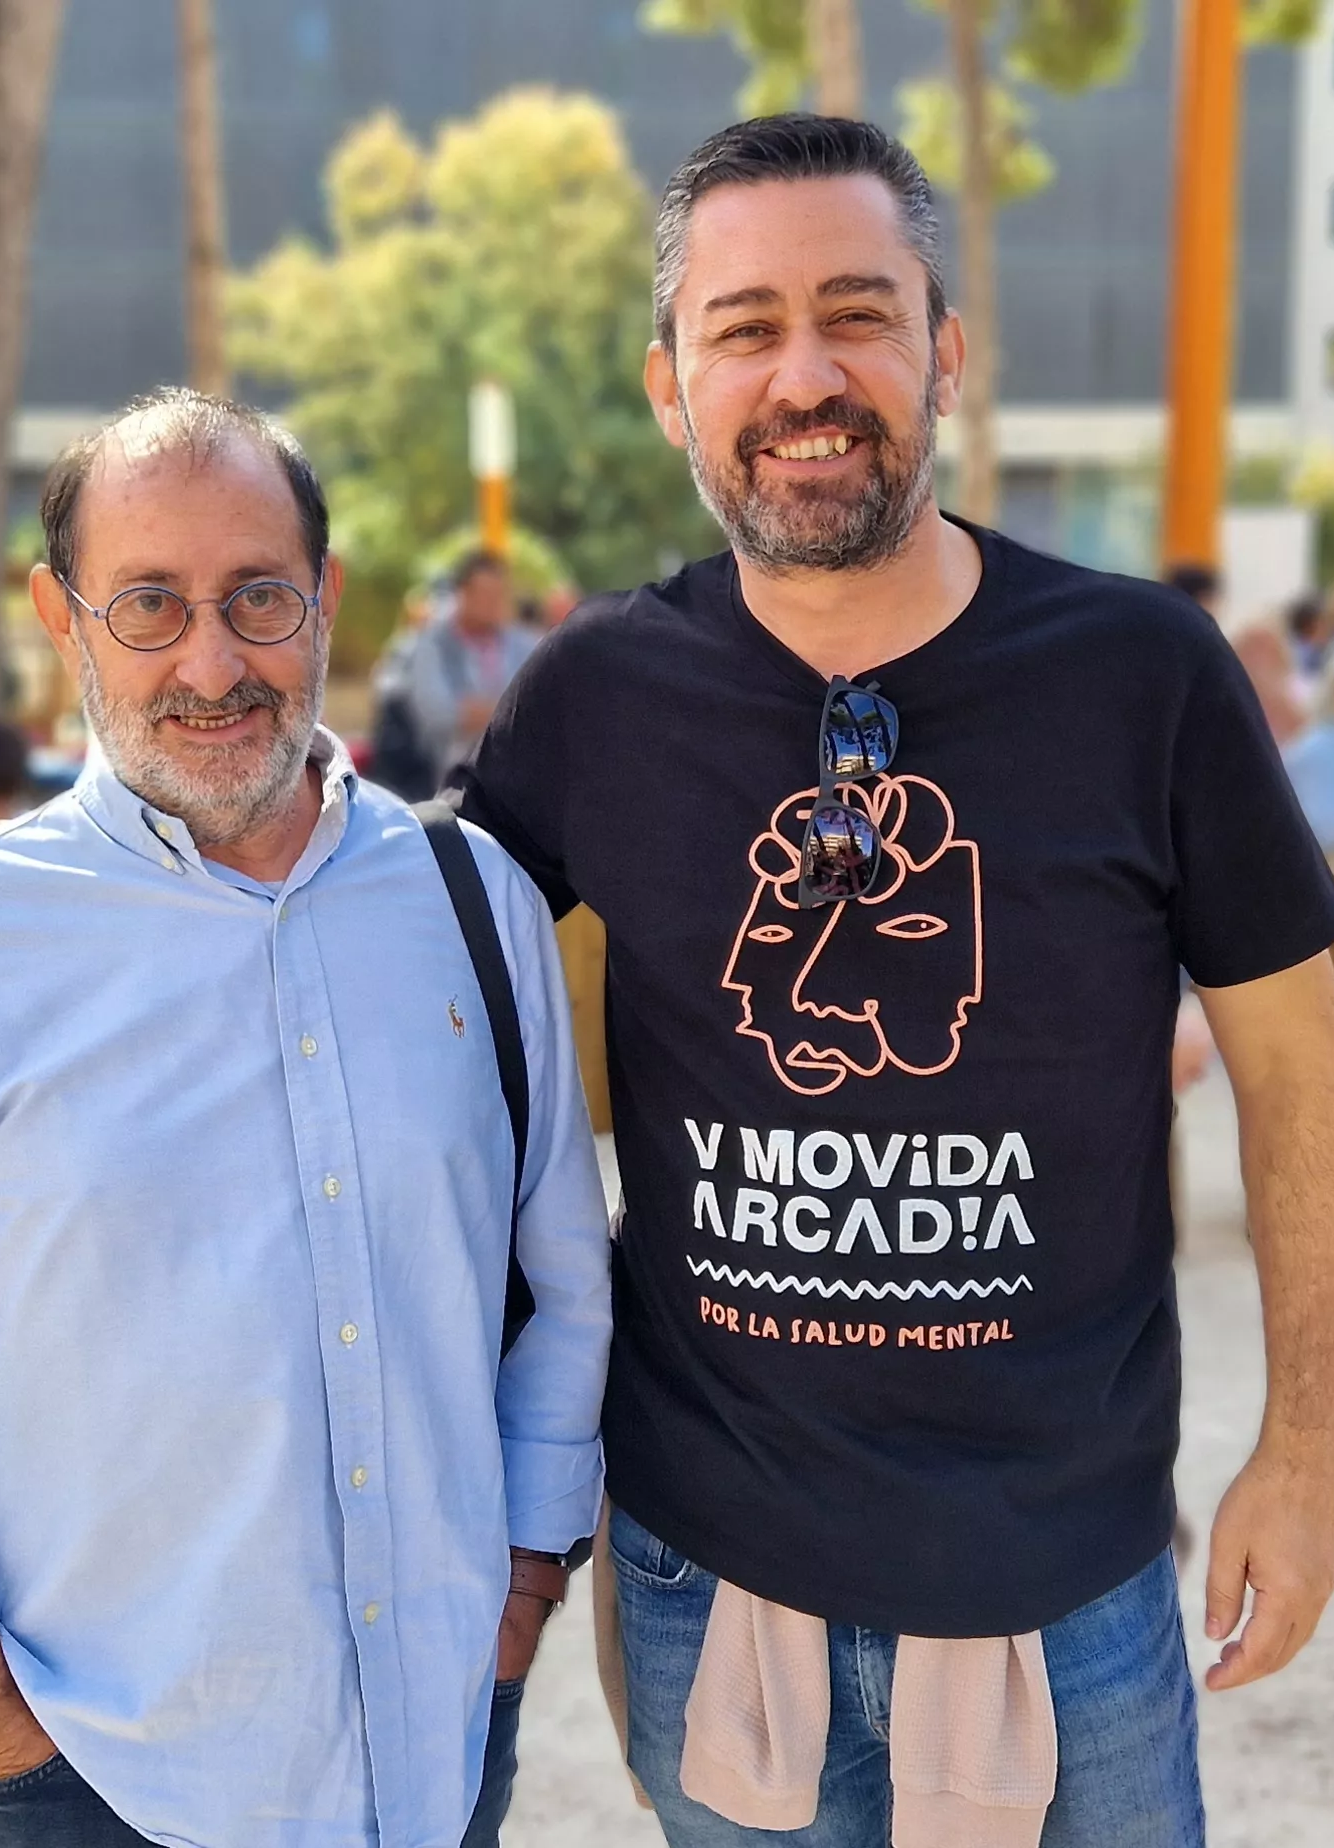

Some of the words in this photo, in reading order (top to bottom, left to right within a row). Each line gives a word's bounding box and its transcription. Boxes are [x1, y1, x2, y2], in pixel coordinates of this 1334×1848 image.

[684, 1118, 724, 1170] V
[699, 1295, 740, 1333] POR
[748, 1313, 780, 1340] LA
[790, 1318, 887, 1347] SALUD
[897, 1318, 1014, 1351] MENTAL
